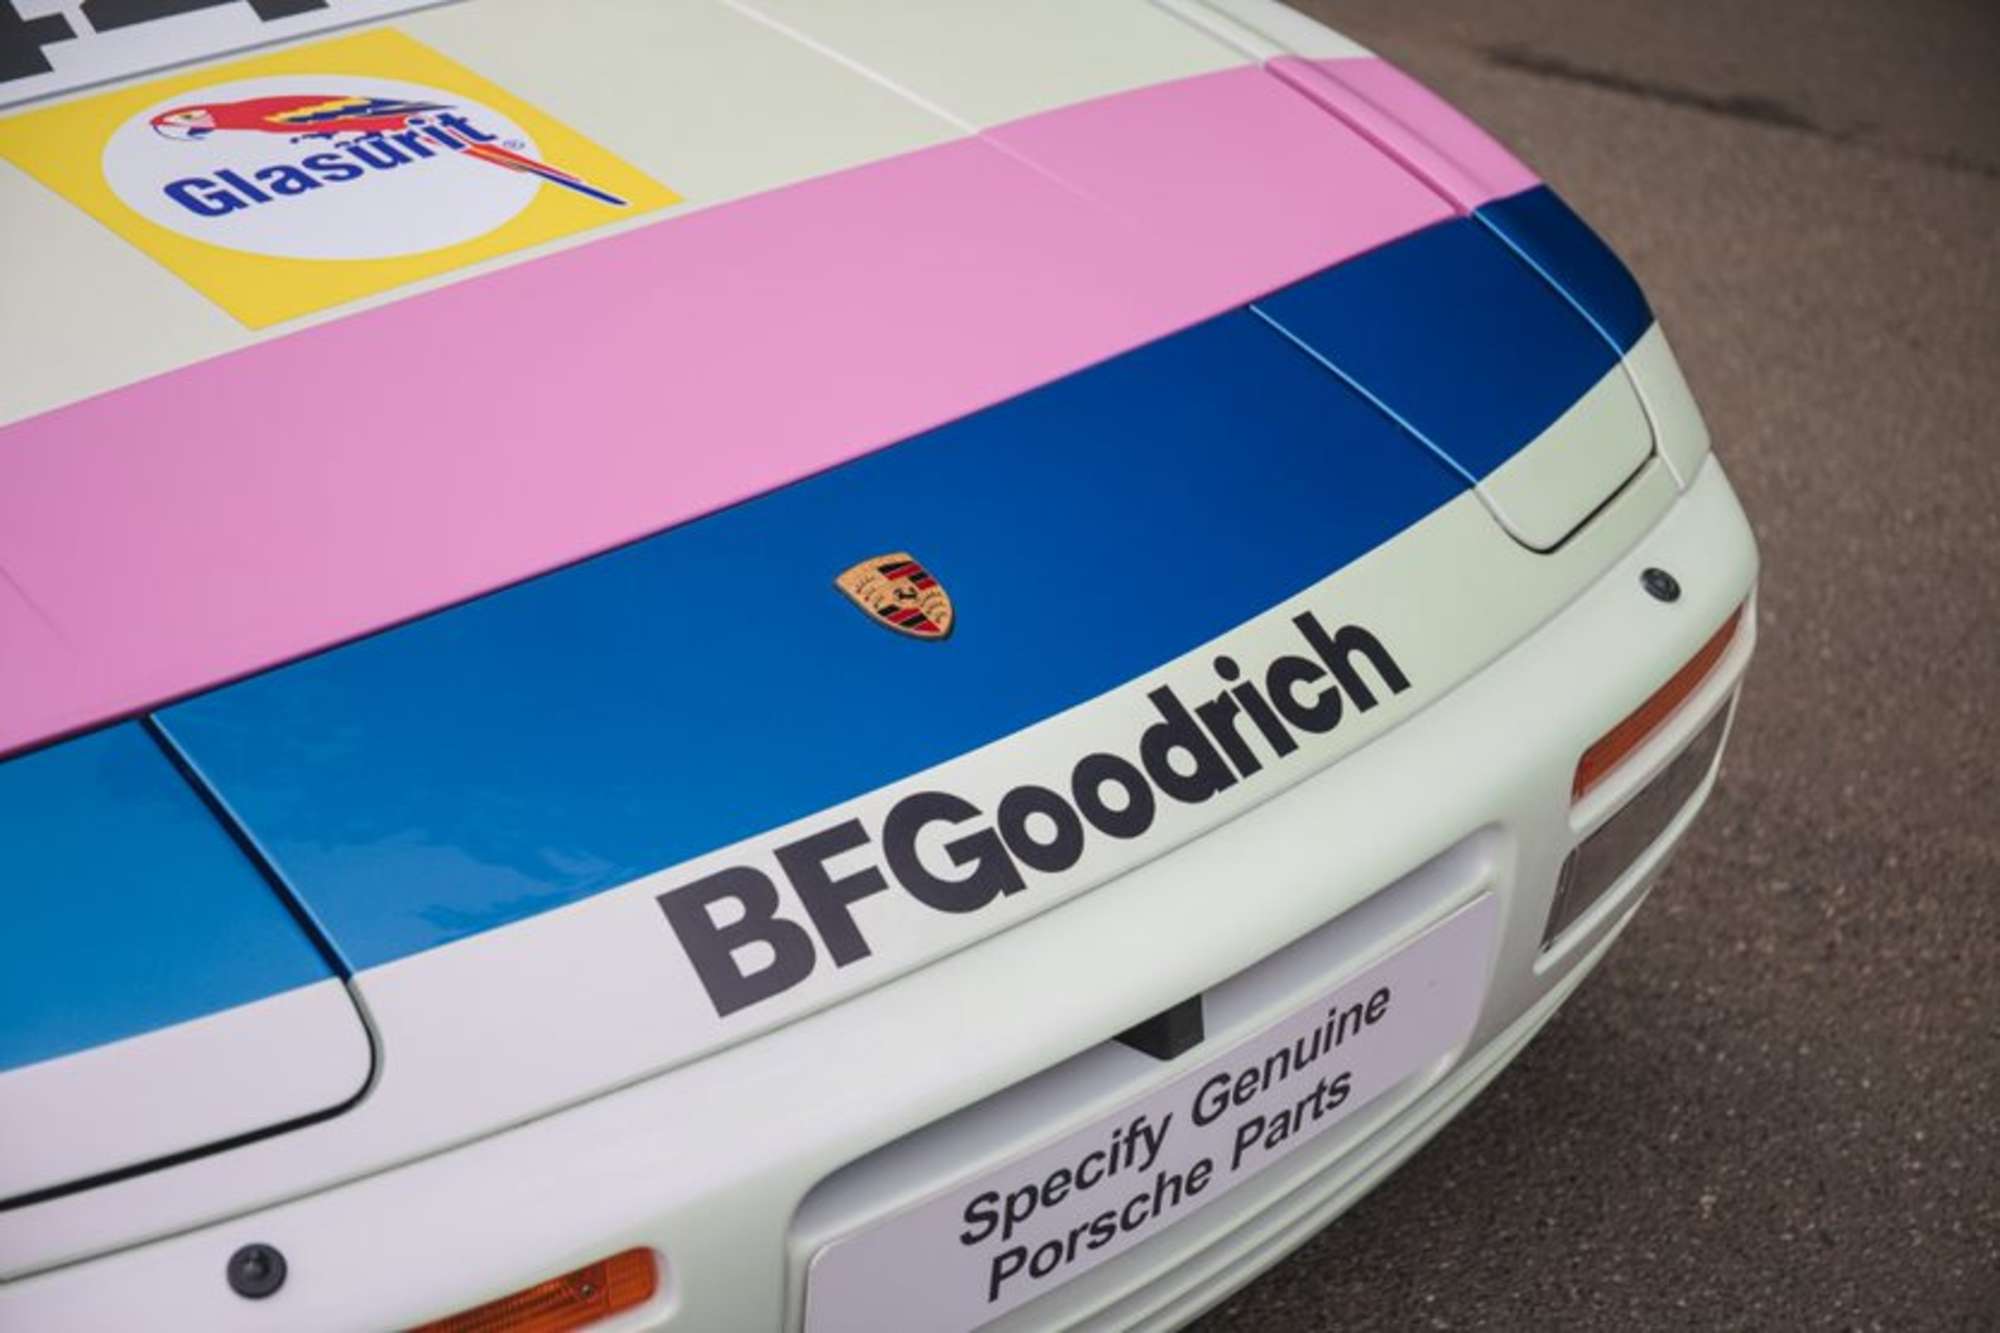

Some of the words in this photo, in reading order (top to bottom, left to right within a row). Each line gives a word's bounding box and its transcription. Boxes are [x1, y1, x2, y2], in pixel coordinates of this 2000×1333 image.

[163, 112, 497, 217] Glasurit
[656, 611, 1411, 1018] BFGoodrich
[959, 1112, 1173, 1246] Specify
[1191, 986, 1391, 1128] Genuine
[988, 1157, 1213, 1303] Porsche
[1231, 1070, 1352, 1171] Parts
